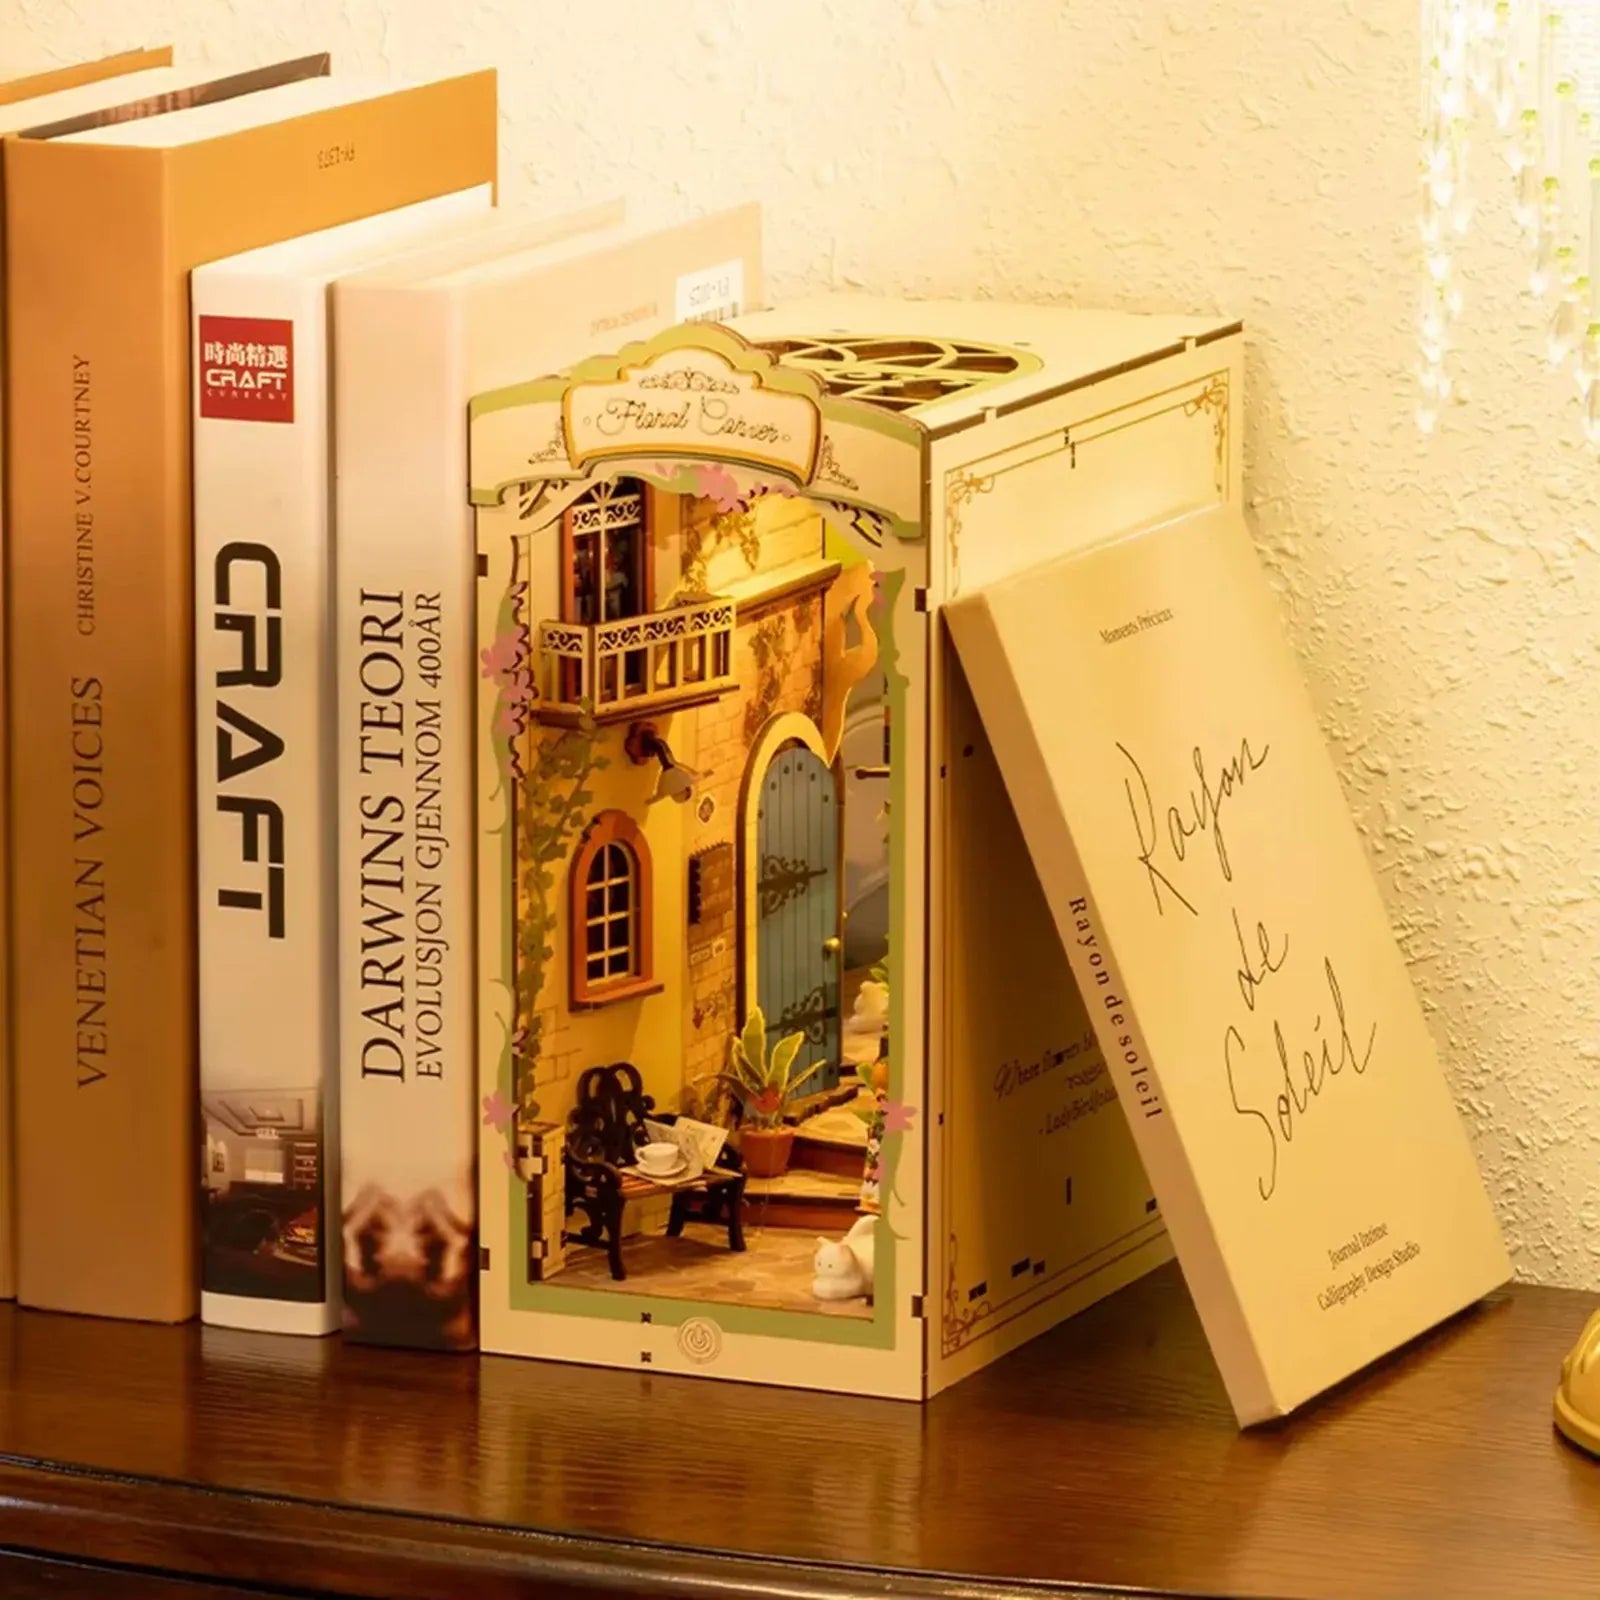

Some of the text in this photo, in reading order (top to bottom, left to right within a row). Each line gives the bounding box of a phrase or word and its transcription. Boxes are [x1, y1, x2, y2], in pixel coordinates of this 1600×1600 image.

[204, 341, 288, 369] 時尚精選
[206, 368, 287, 390] CRAFT
[596, 395, 780, 443] Floral Corner
[72, 354, 96, 636] CHRISTINE V.COURTNEY
[213, 540, 287, 940] CRAFT
[71, 675, 109, 1089] VENETIAN VOICES
[358, 587, 407, 1085] DARWINS TEORI
[408, 591, 451, 1082] EVOLUSJON GJENNOM 400ÅR
[1069, 897, 1163, 1119] Rayon de soleil
[1230, 907, 1289, 1011] de
[1317, 1273, 1367, 1311] Calligraphy
[1327, 1233, 1361, 1270] Journal
